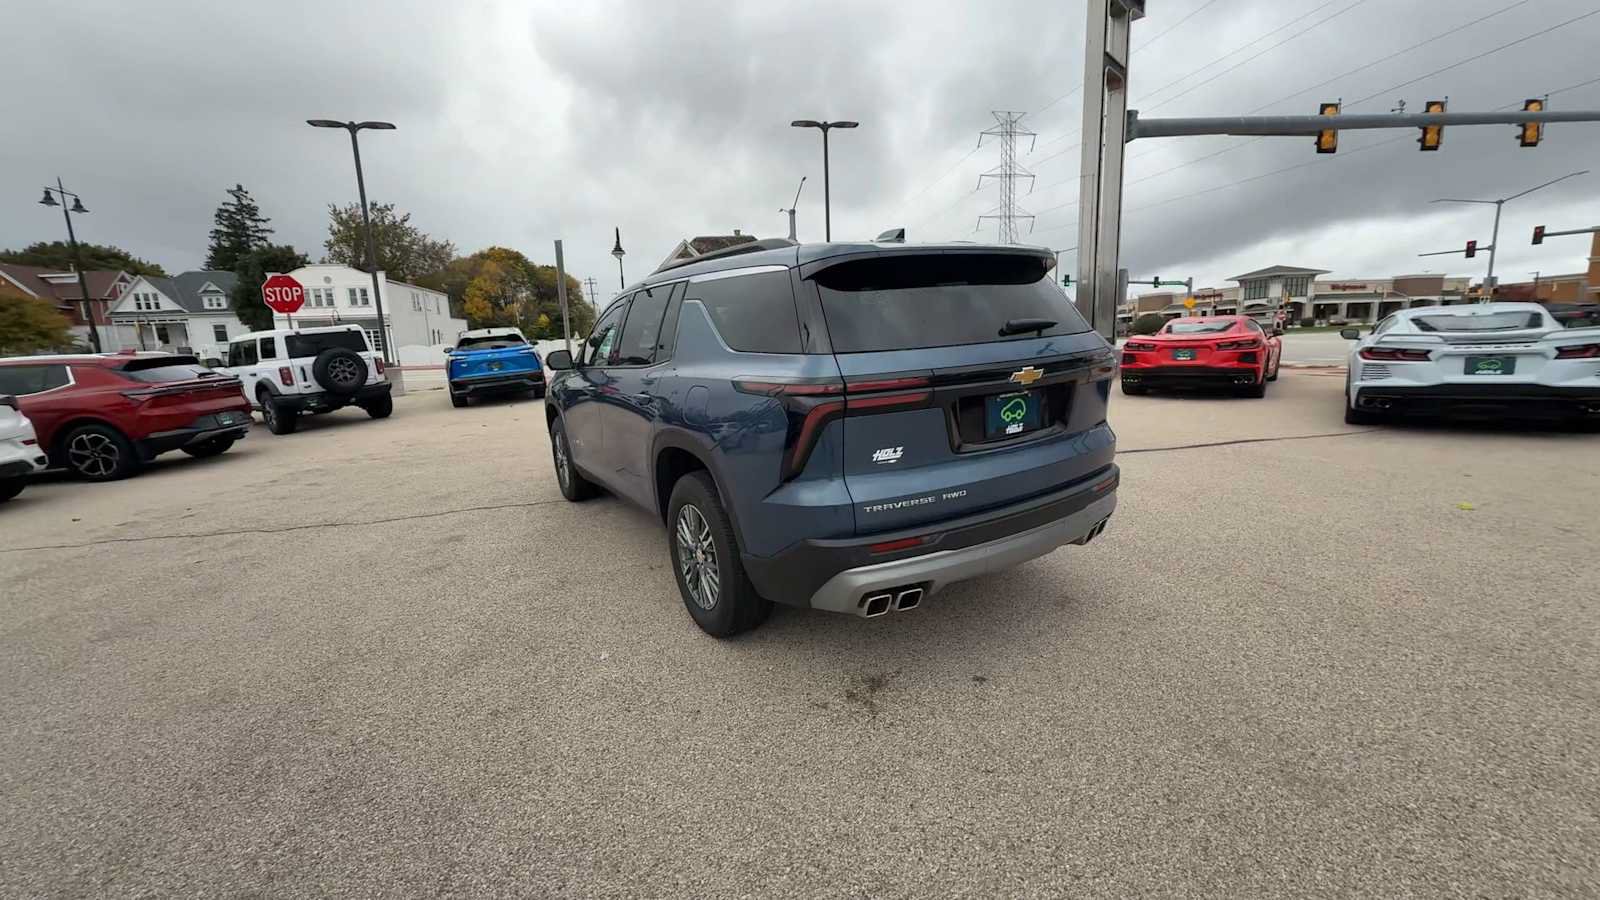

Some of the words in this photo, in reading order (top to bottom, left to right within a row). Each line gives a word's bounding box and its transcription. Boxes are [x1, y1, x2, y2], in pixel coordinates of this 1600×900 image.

[265, 286, 302, 302] STOP
[872, 446, 904, 461] HOLZ
[864, 496, 936, 512] TRAVERSE
[942, 489, 967, 500] AWD
